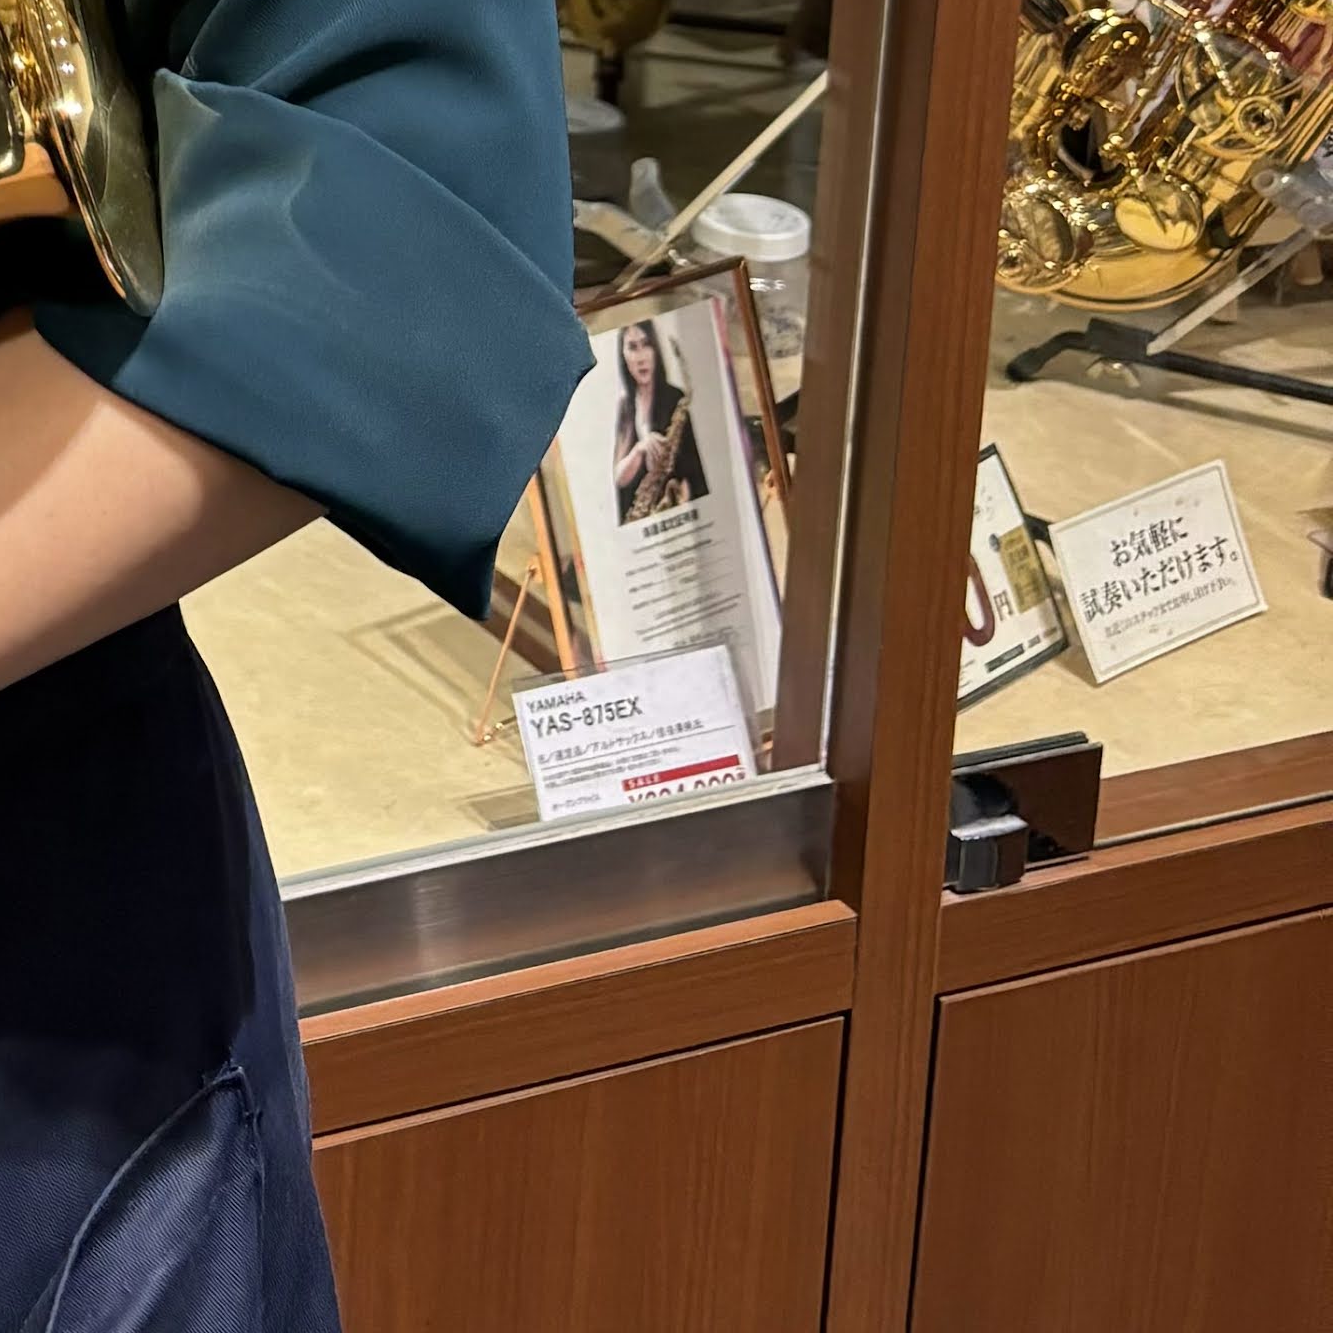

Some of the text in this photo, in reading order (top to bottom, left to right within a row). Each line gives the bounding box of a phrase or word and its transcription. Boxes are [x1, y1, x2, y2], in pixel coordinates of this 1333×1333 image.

[1109, 516, 1189, 568] お気軽に
[526, 690, 587, 713] YAMAHA
[530, 696, 643, 739] YAS-875EX
